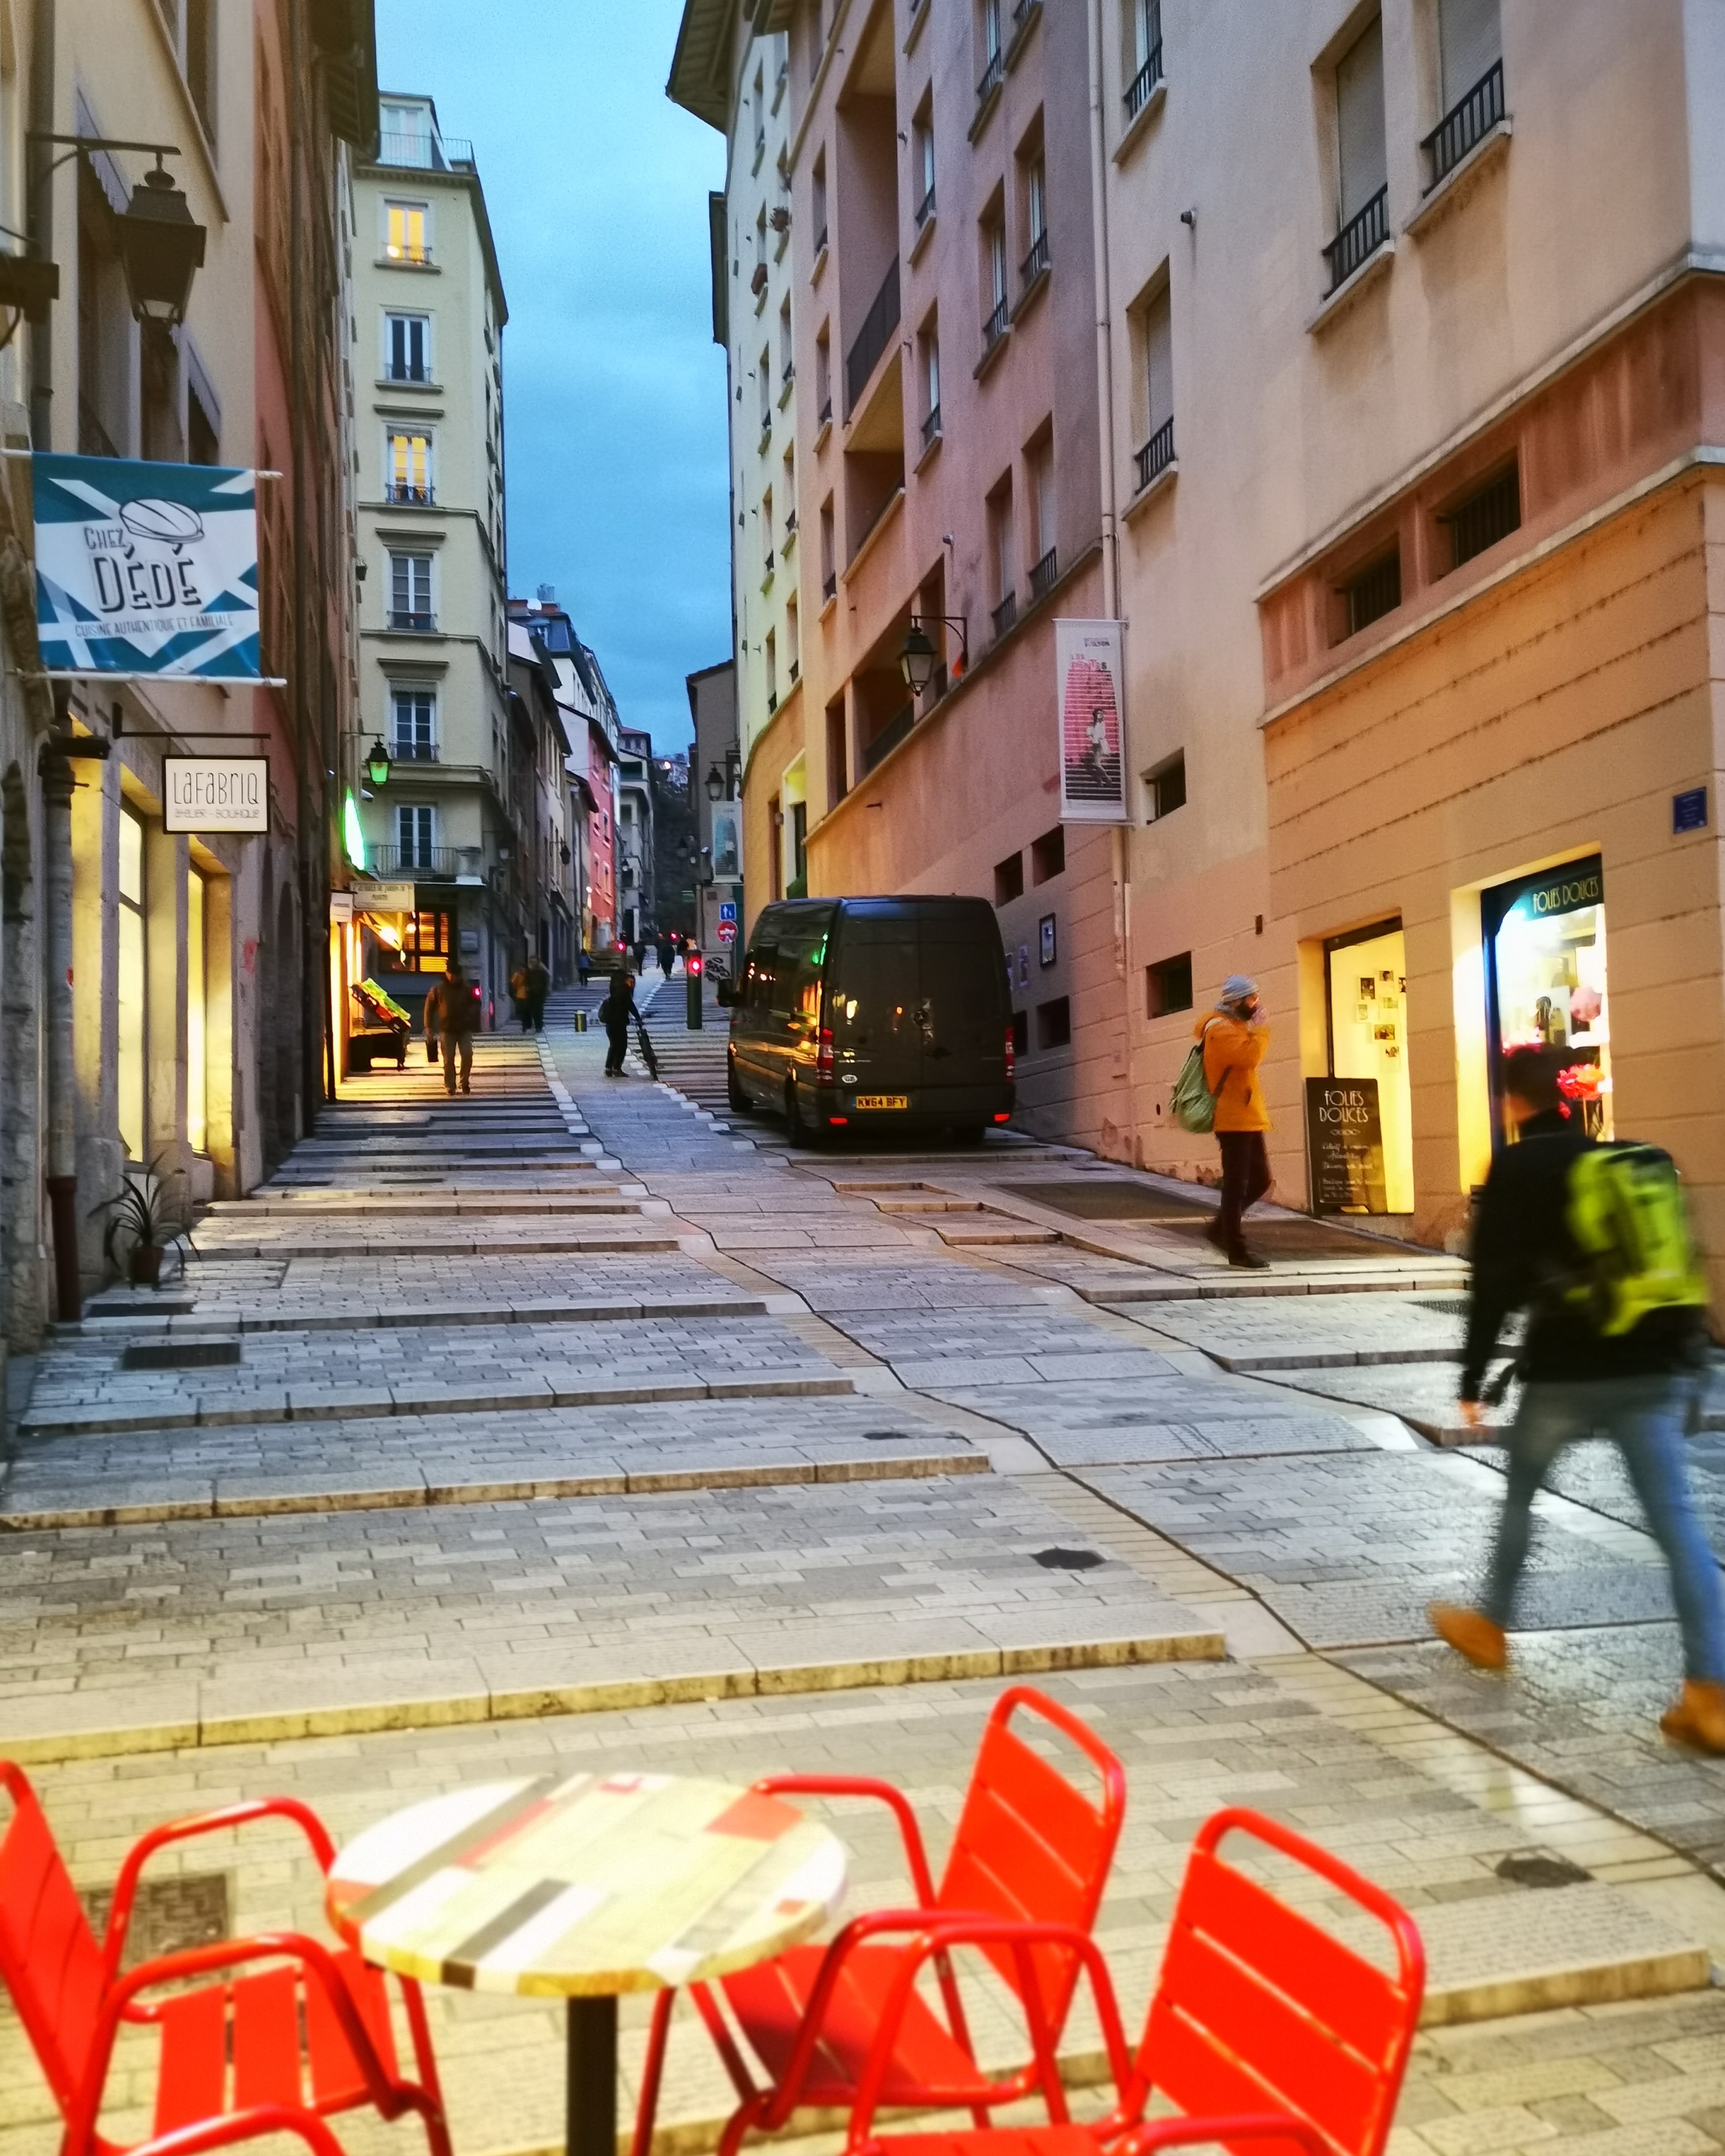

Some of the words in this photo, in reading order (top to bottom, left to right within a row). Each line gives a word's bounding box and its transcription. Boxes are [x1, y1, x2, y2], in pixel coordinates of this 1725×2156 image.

[84, 526, 127, 550] CHEZ
[90, 542, 202, 613] DÉDÉ
[75, 622, 112, 637] CUISINE
[115, 619, 175, 635] AUTHENTIQUE
[177, 617, 189, 630] ET
[190, 614, 233, 629] FAMILIALE
[1533, 887, 1560, 914] FOLIES
[1562, 876, 1599, 906] DOUCES
[886, 1098, 905, 1107] BFY
[1324, 1091, 1364, 1106] FOLIES
[1319, 1106, 1369, 1123] DOUCES
